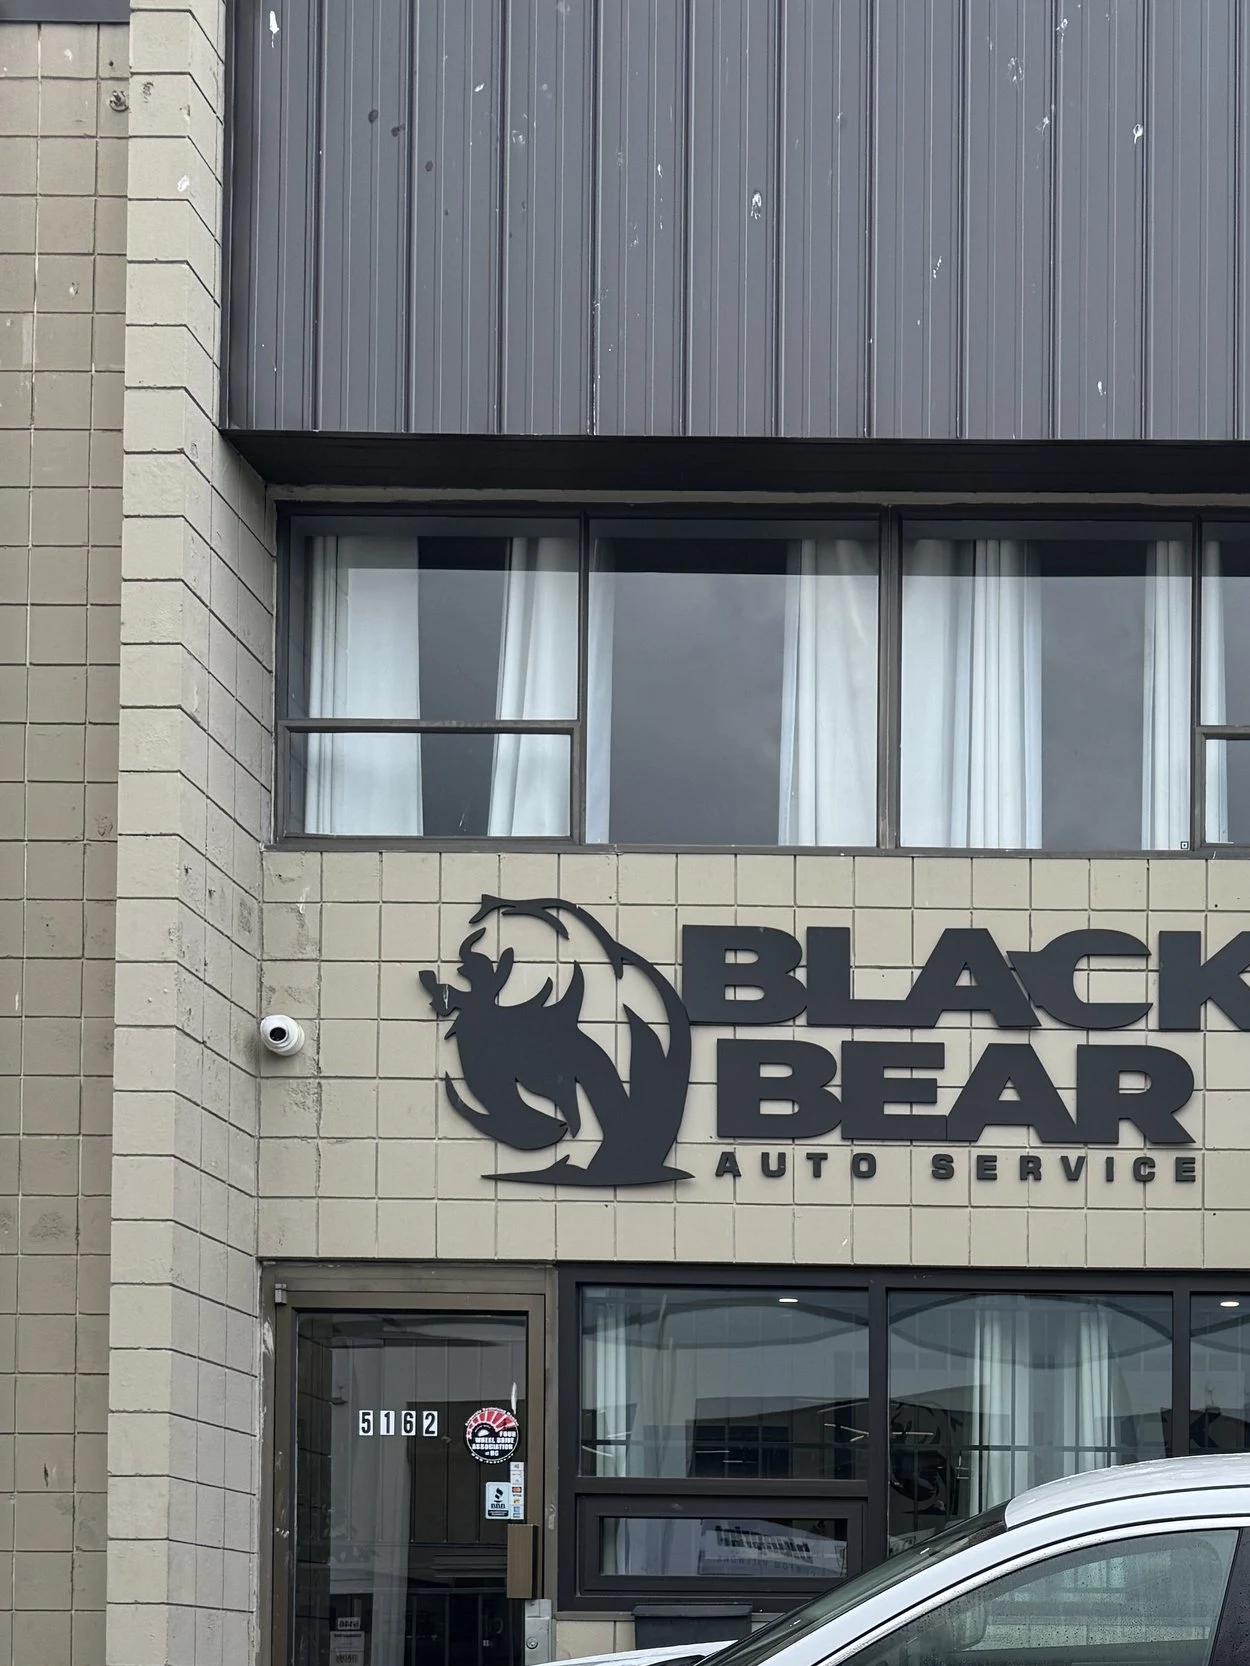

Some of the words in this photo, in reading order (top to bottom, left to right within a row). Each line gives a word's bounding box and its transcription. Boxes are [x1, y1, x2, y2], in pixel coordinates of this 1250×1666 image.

[717, 1039, 1196, 1144] BEAR
[716, 1151, 877, 1180] AUTO
[932, 1154, 1199, 1182] SERVICE
[360, 1411, 435, 1435] 5162
